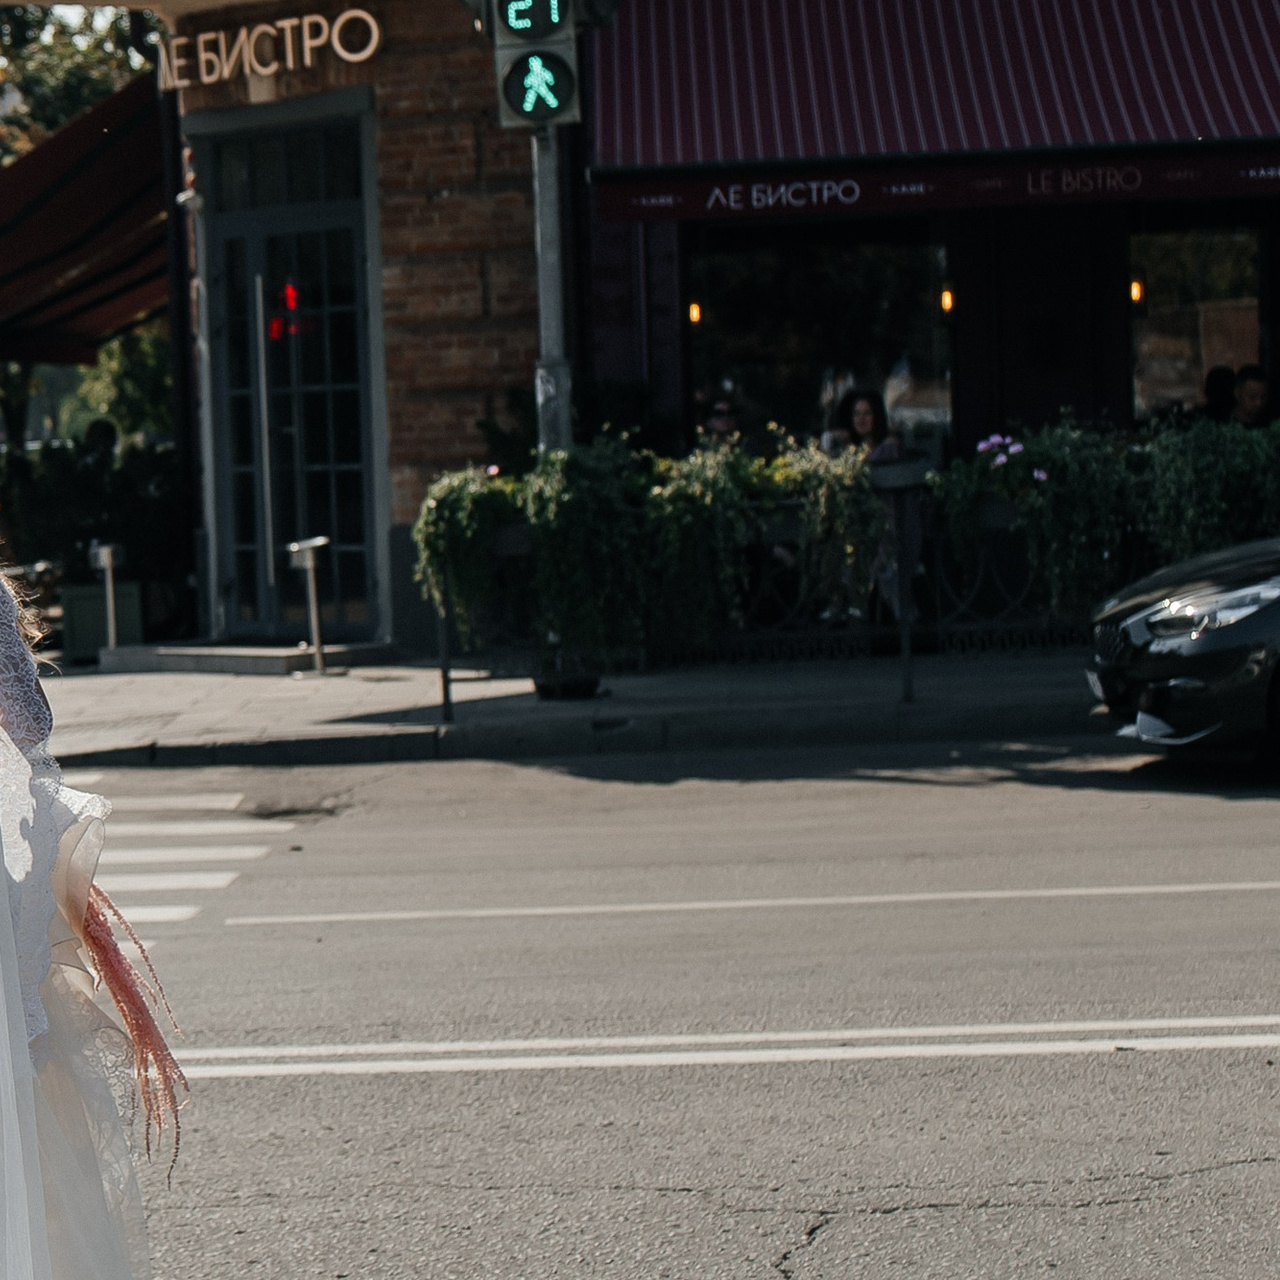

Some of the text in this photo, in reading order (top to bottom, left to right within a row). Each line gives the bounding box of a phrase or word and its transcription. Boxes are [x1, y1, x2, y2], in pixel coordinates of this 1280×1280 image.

[197, 8, 380, 85] БИСТРО
[705, 179, 861, 211] ЛЕ БИСТРО
[1026, 170, 1051, 195] LE
[1062, 166, 1142, 193] BISTRO
